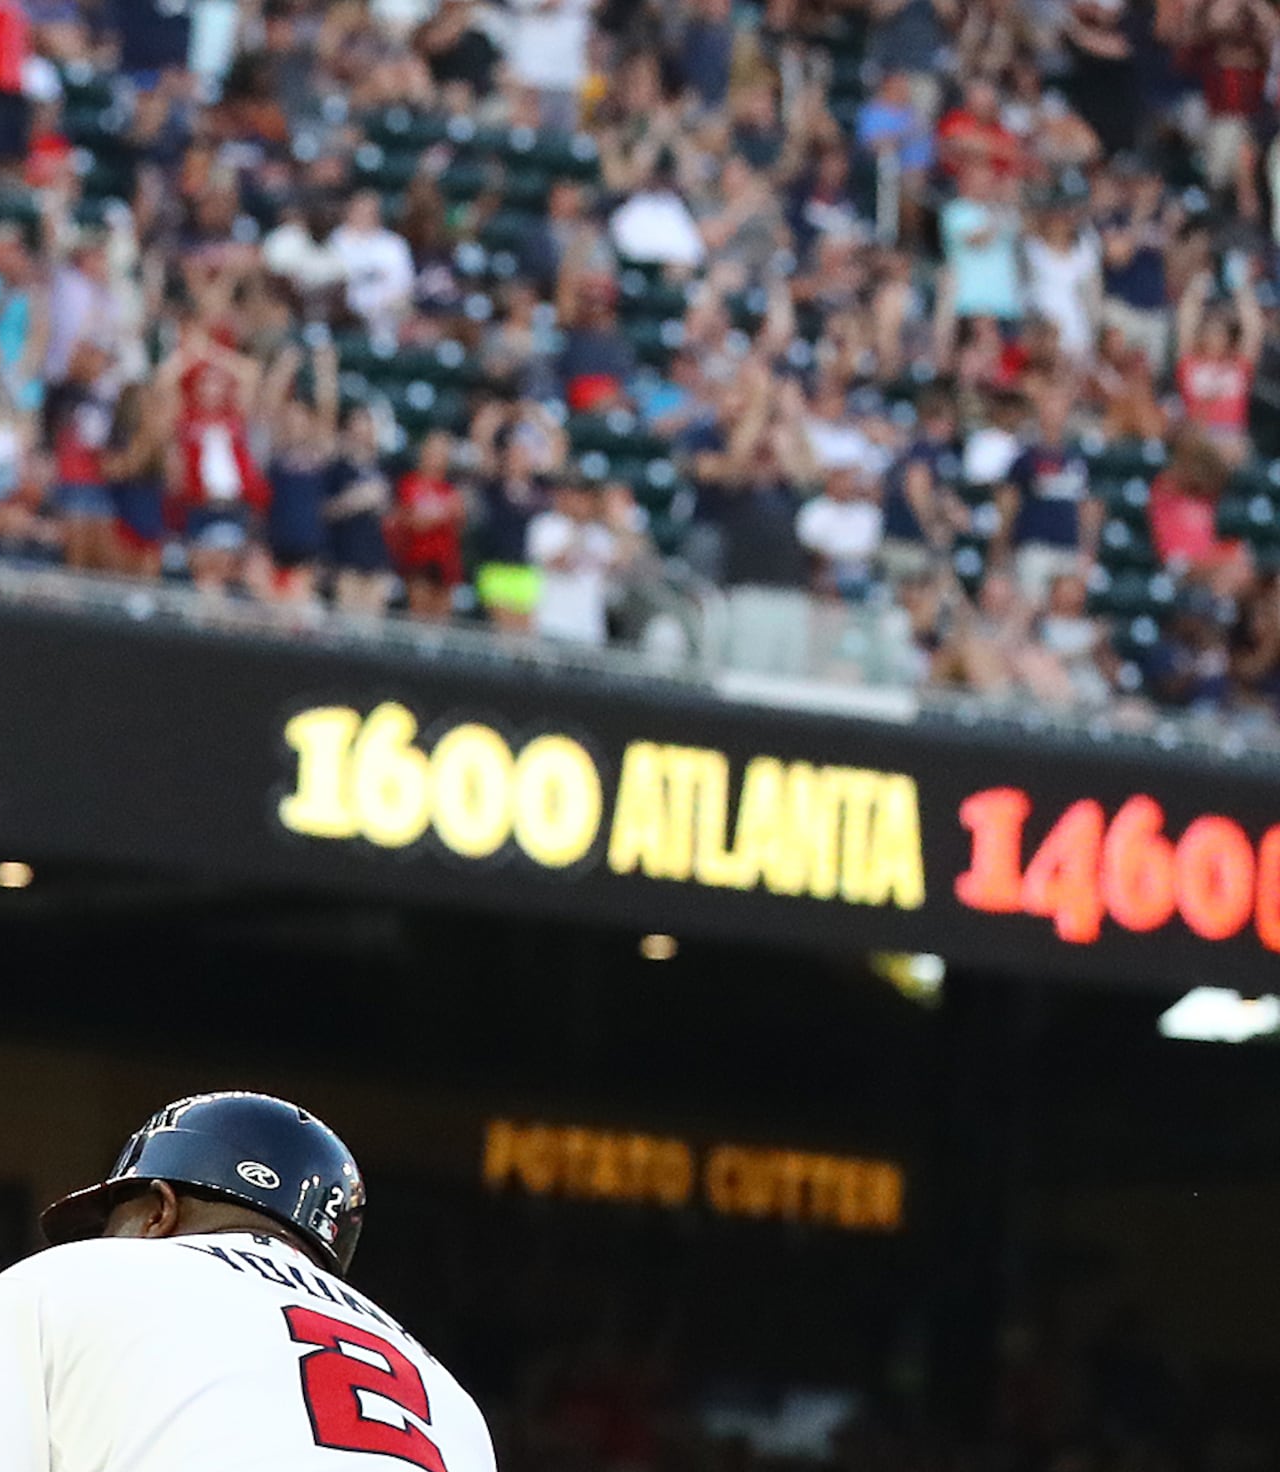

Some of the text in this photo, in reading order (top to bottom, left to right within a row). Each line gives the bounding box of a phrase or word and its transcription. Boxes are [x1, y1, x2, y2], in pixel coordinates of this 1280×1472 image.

[279, 701, 603, 868] 1600
[607, 740, 926, 910] ATLANTA
[324, 1186, 345, 1219] 2
[483, 1119, 693, 1208] POTATO
